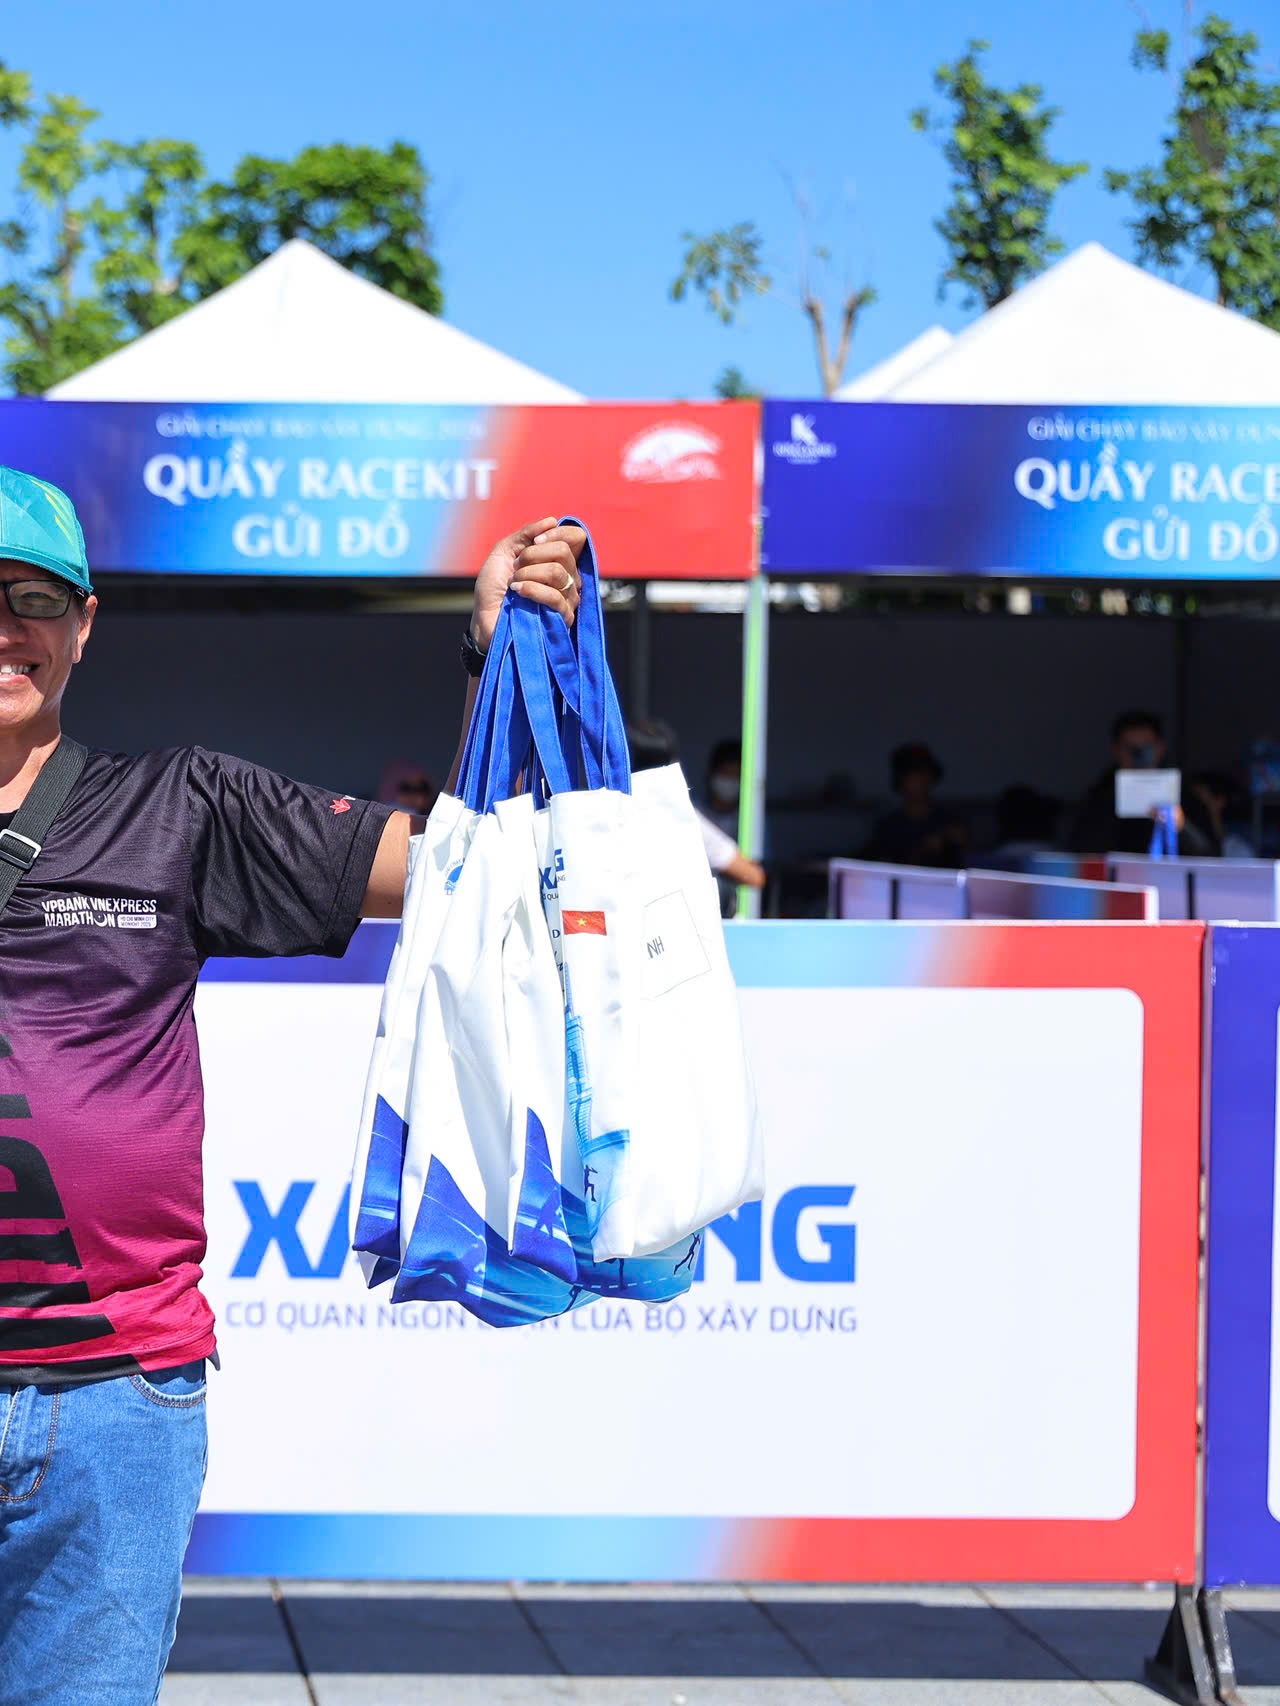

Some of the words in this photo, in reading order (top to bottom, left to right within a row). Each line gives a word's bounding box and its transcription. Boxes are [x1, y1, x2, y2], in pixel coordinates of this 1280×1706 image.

[298, 456, 497, 500] RACEKIT
[41, 896, 90, 912] VPBANK
[89, 898, 157, 913] VNEXPRESS
[44, 911, 116, 927] MARATHON
[276, 1302, 365, 1334] QUAN
